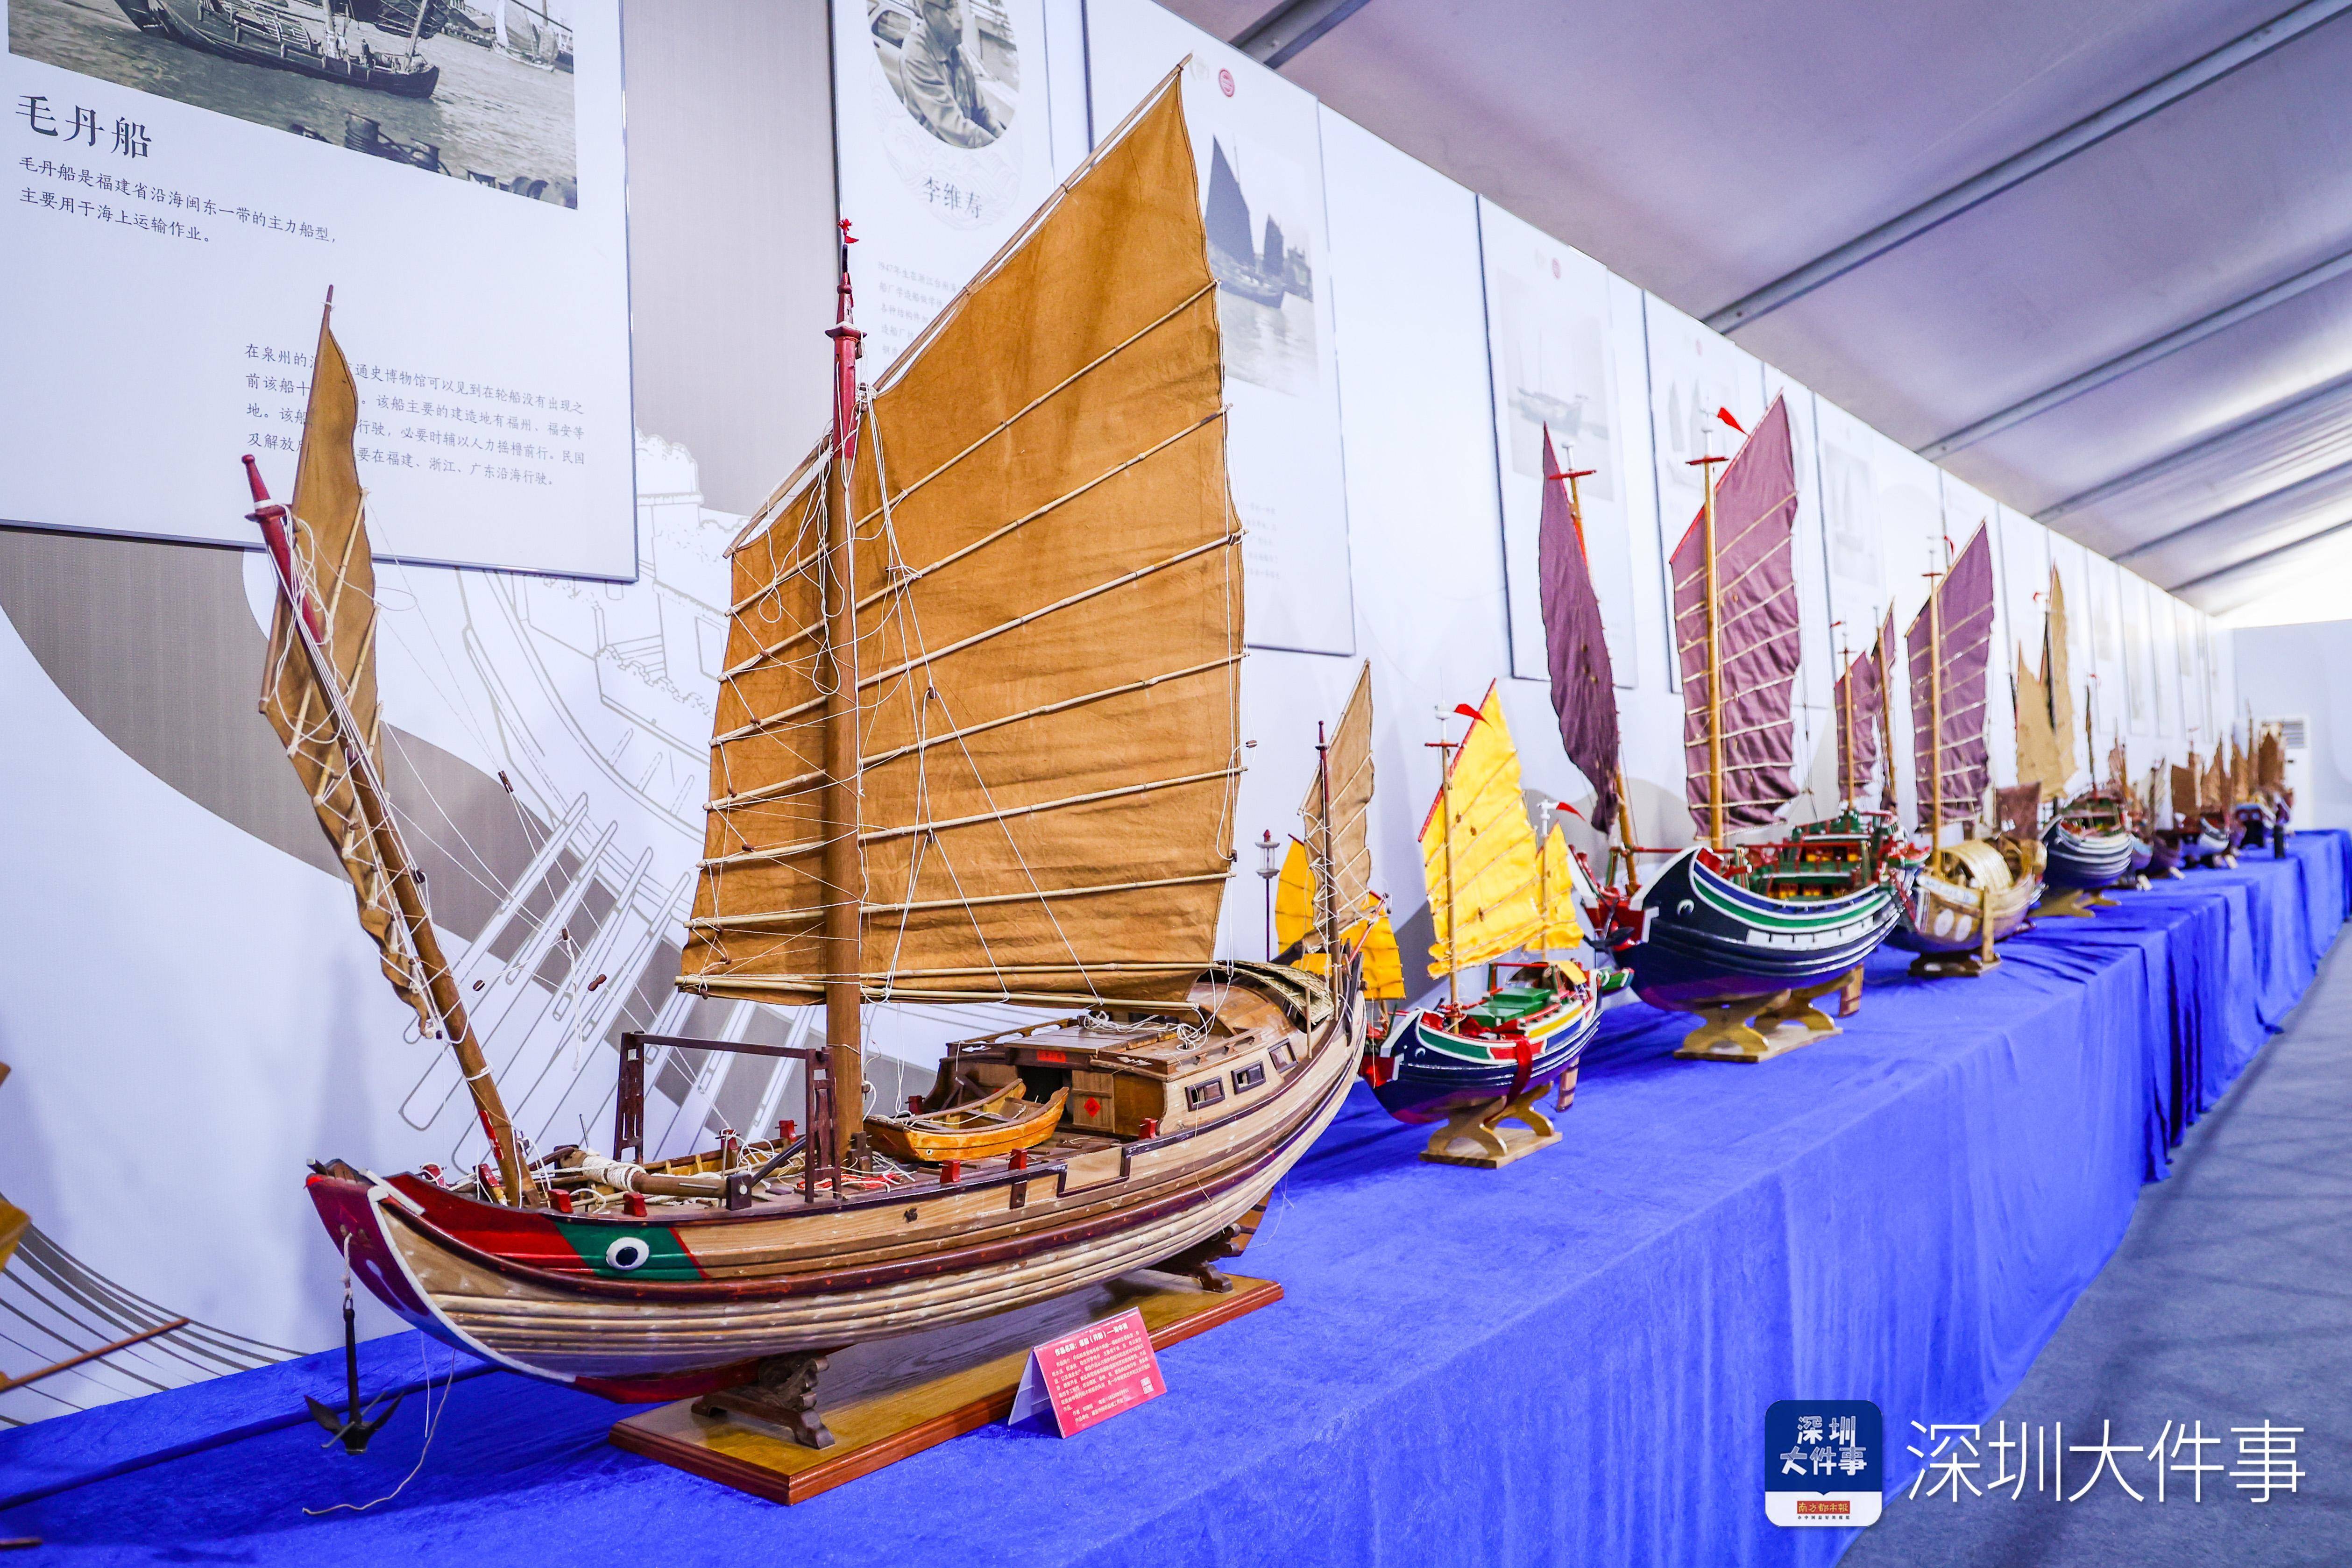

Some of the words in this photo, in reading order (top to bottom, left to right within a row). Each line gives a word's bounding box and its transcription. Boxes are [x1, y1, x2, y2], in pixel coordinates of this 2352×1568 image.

[15, 95, 152, 158] 毛丹船
[19, 157, 336, 243] 毛丹船是福建省沿海闽东一带的主力船型，
[19, 187, 209, 242] 主要用于海上运输作业。
[922, 176, 982, 219] 李维寿
